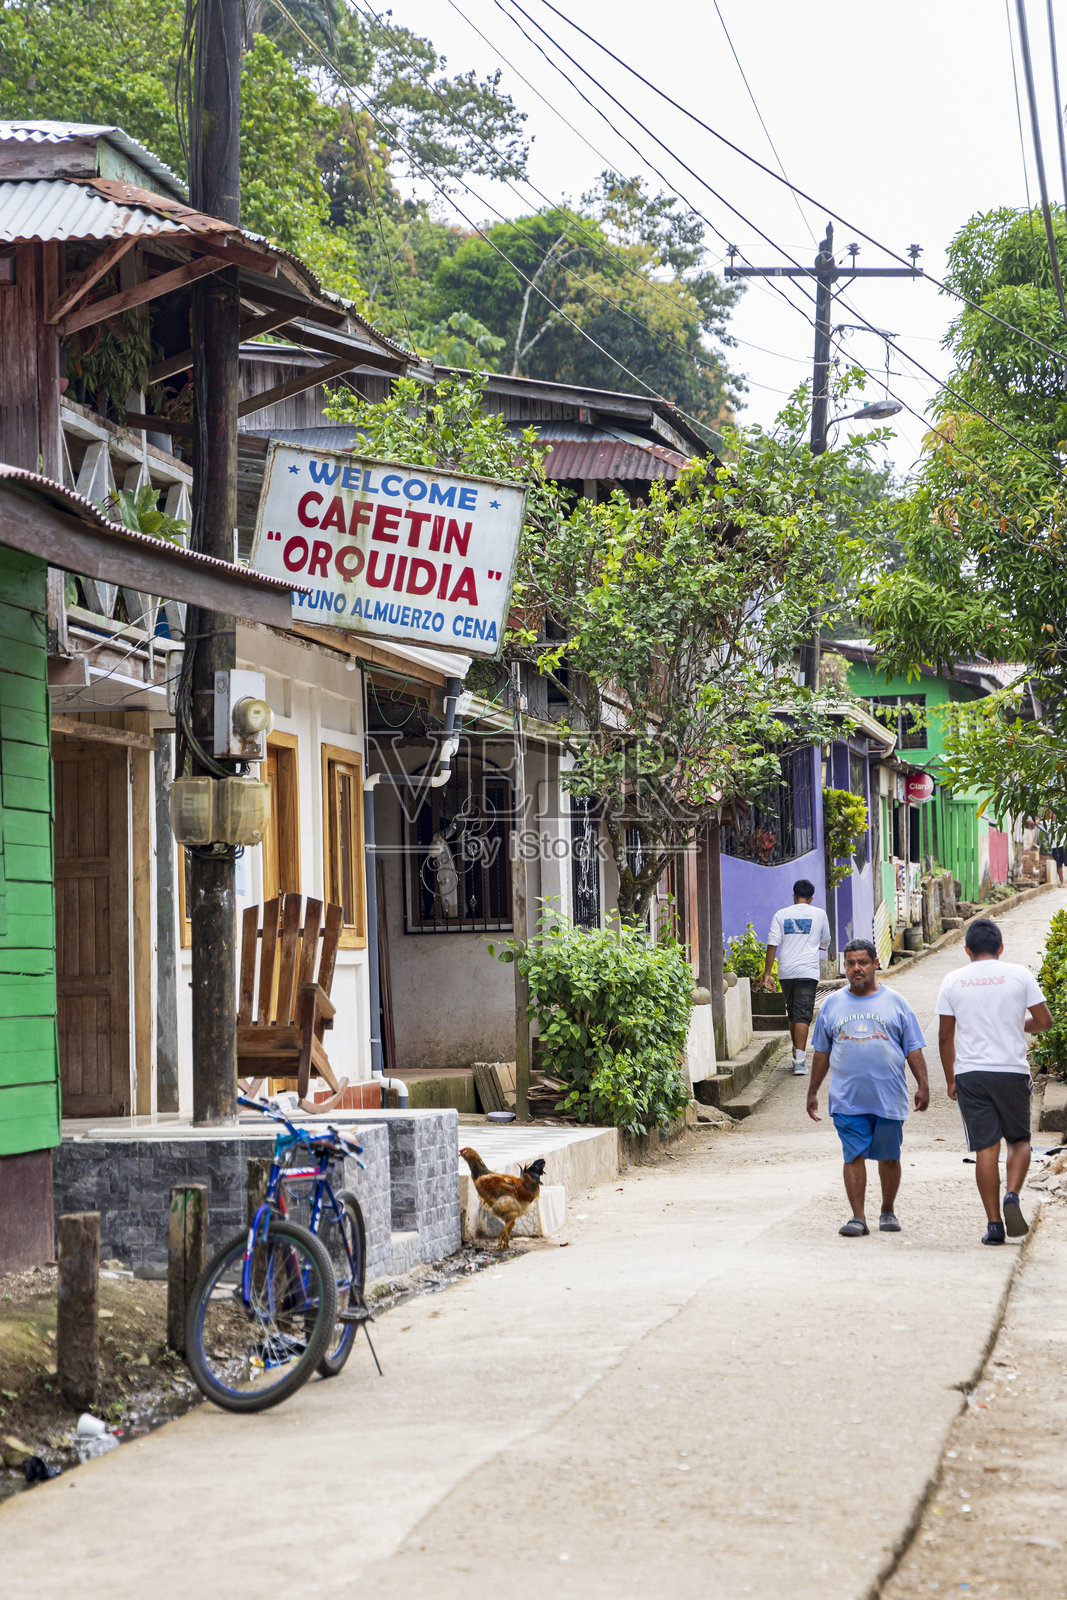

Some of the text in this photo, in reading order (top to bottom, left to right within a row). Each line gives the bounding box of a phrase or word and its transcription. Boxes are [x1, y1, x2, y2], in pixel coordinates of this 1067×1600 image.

[309, 460, 478, 511] WELCOME
[298, 490, 473, 557] CAFETIN
[351, 597, 445, 632] ALMUERZO
[452, 615, 498, 642] CENA
[909, 782, 930, 790] Claro
